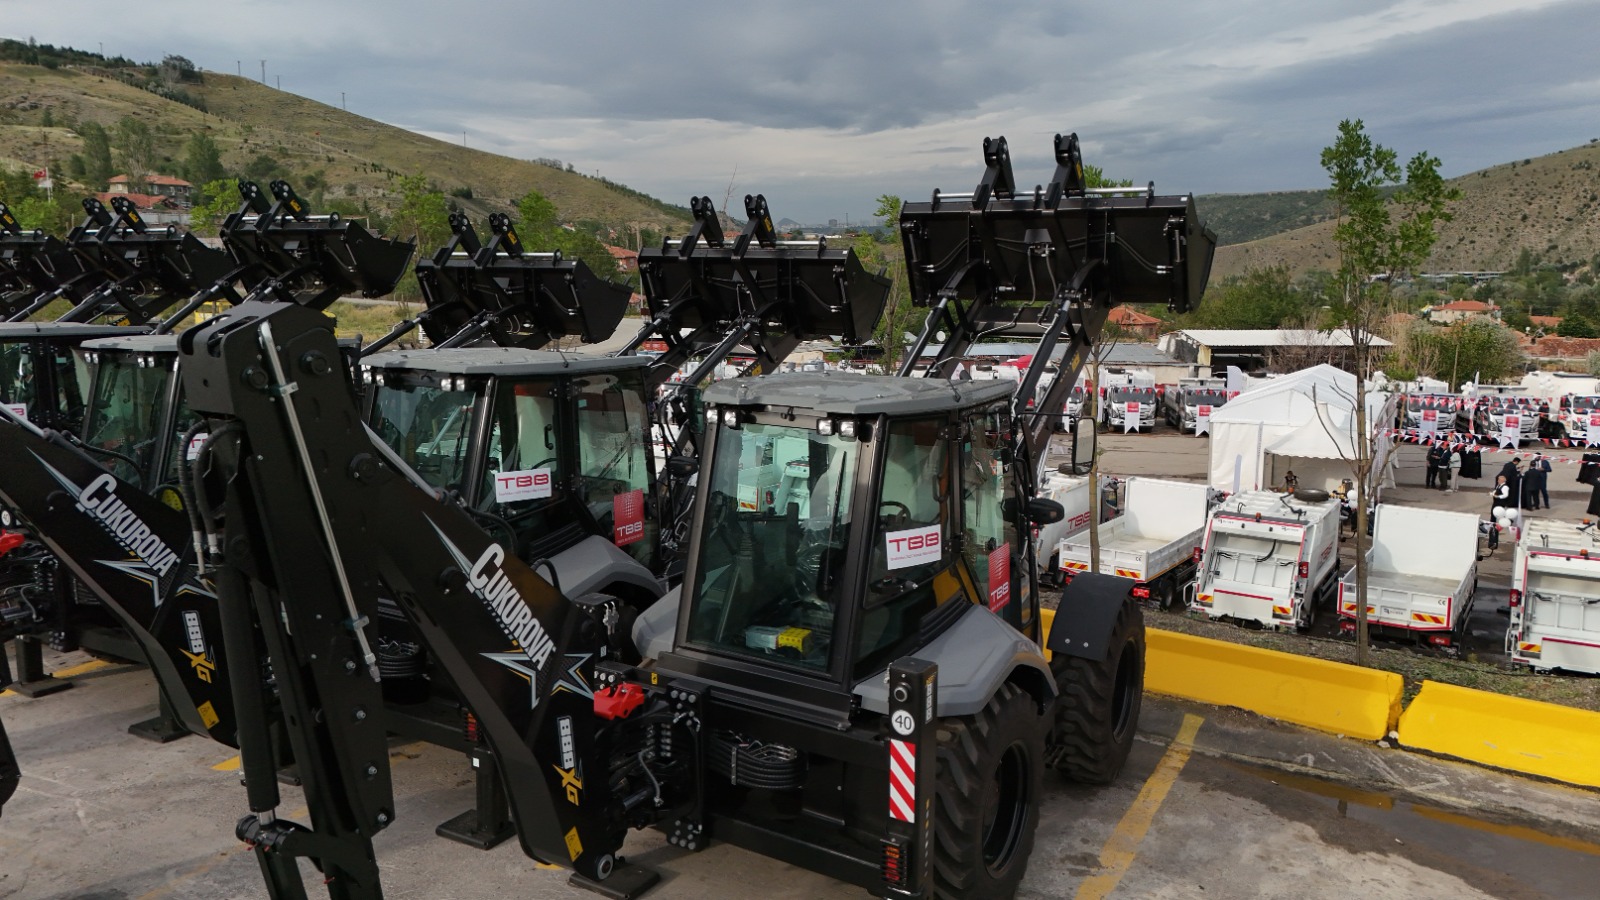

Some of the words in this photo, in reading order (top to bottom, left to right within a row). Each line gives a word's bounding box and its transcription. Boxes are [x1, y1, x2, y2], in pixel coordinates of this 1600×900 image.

[498, 473, 549, 490] TBB
[616, 521, 643, 537] TBB
[888, 532, 939, 553] TBB
[990, 581, 1009, 603] TBB
[894, 714, 912, 732] 40
